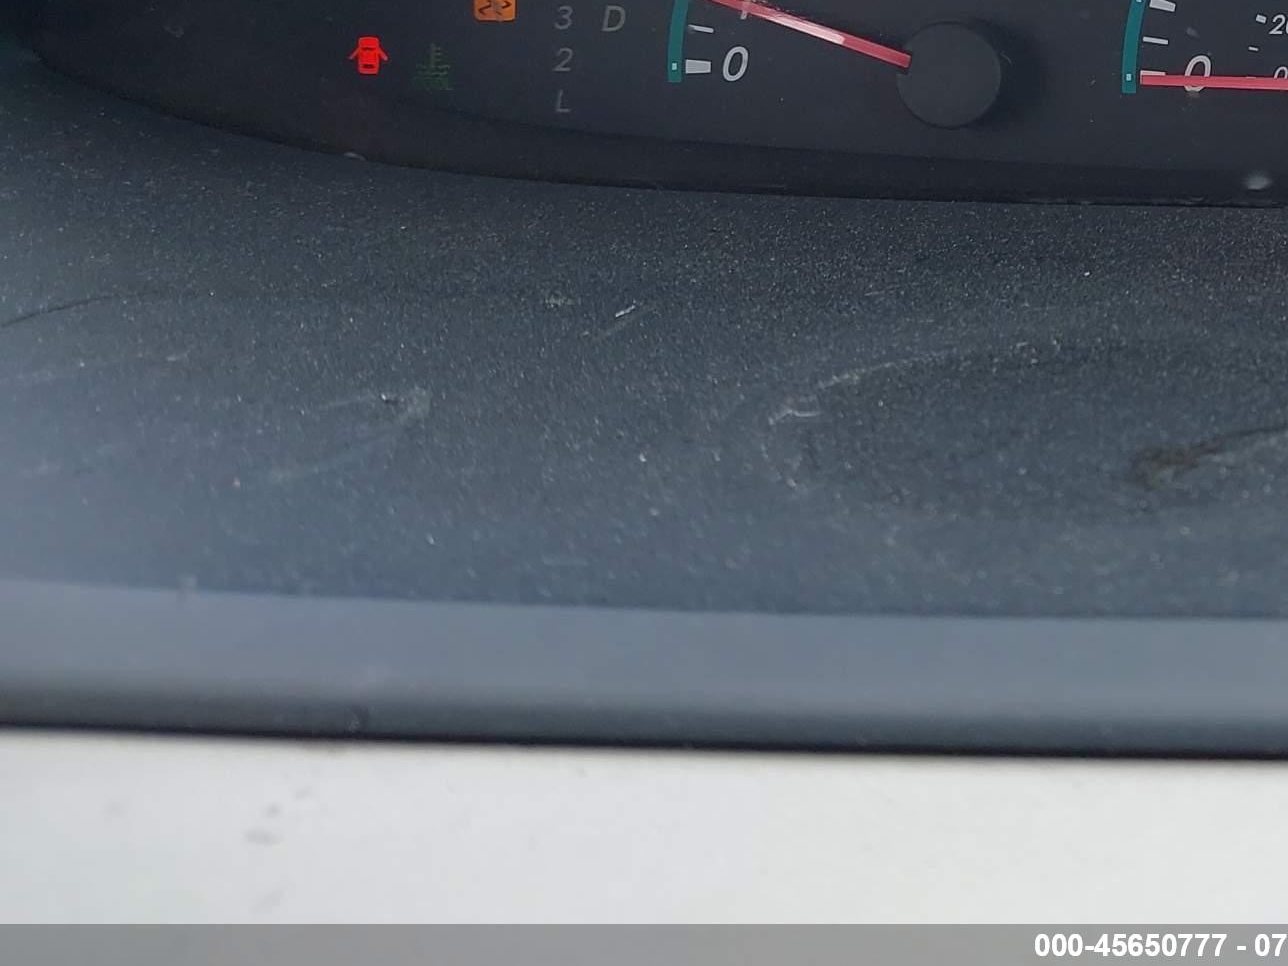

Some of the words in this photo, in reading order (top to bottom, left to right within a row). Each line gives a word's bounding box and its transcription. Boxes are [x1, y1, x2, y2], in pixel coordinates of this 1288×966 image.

[554, 6, 573, 29] 3
[601, 6, 626, 32] D
[552, 48, 573, 72] 2
[722, 46, 748, 82] 0
[1185, 55, 1211, 92] 0
[555, 90, 571, 113] L
